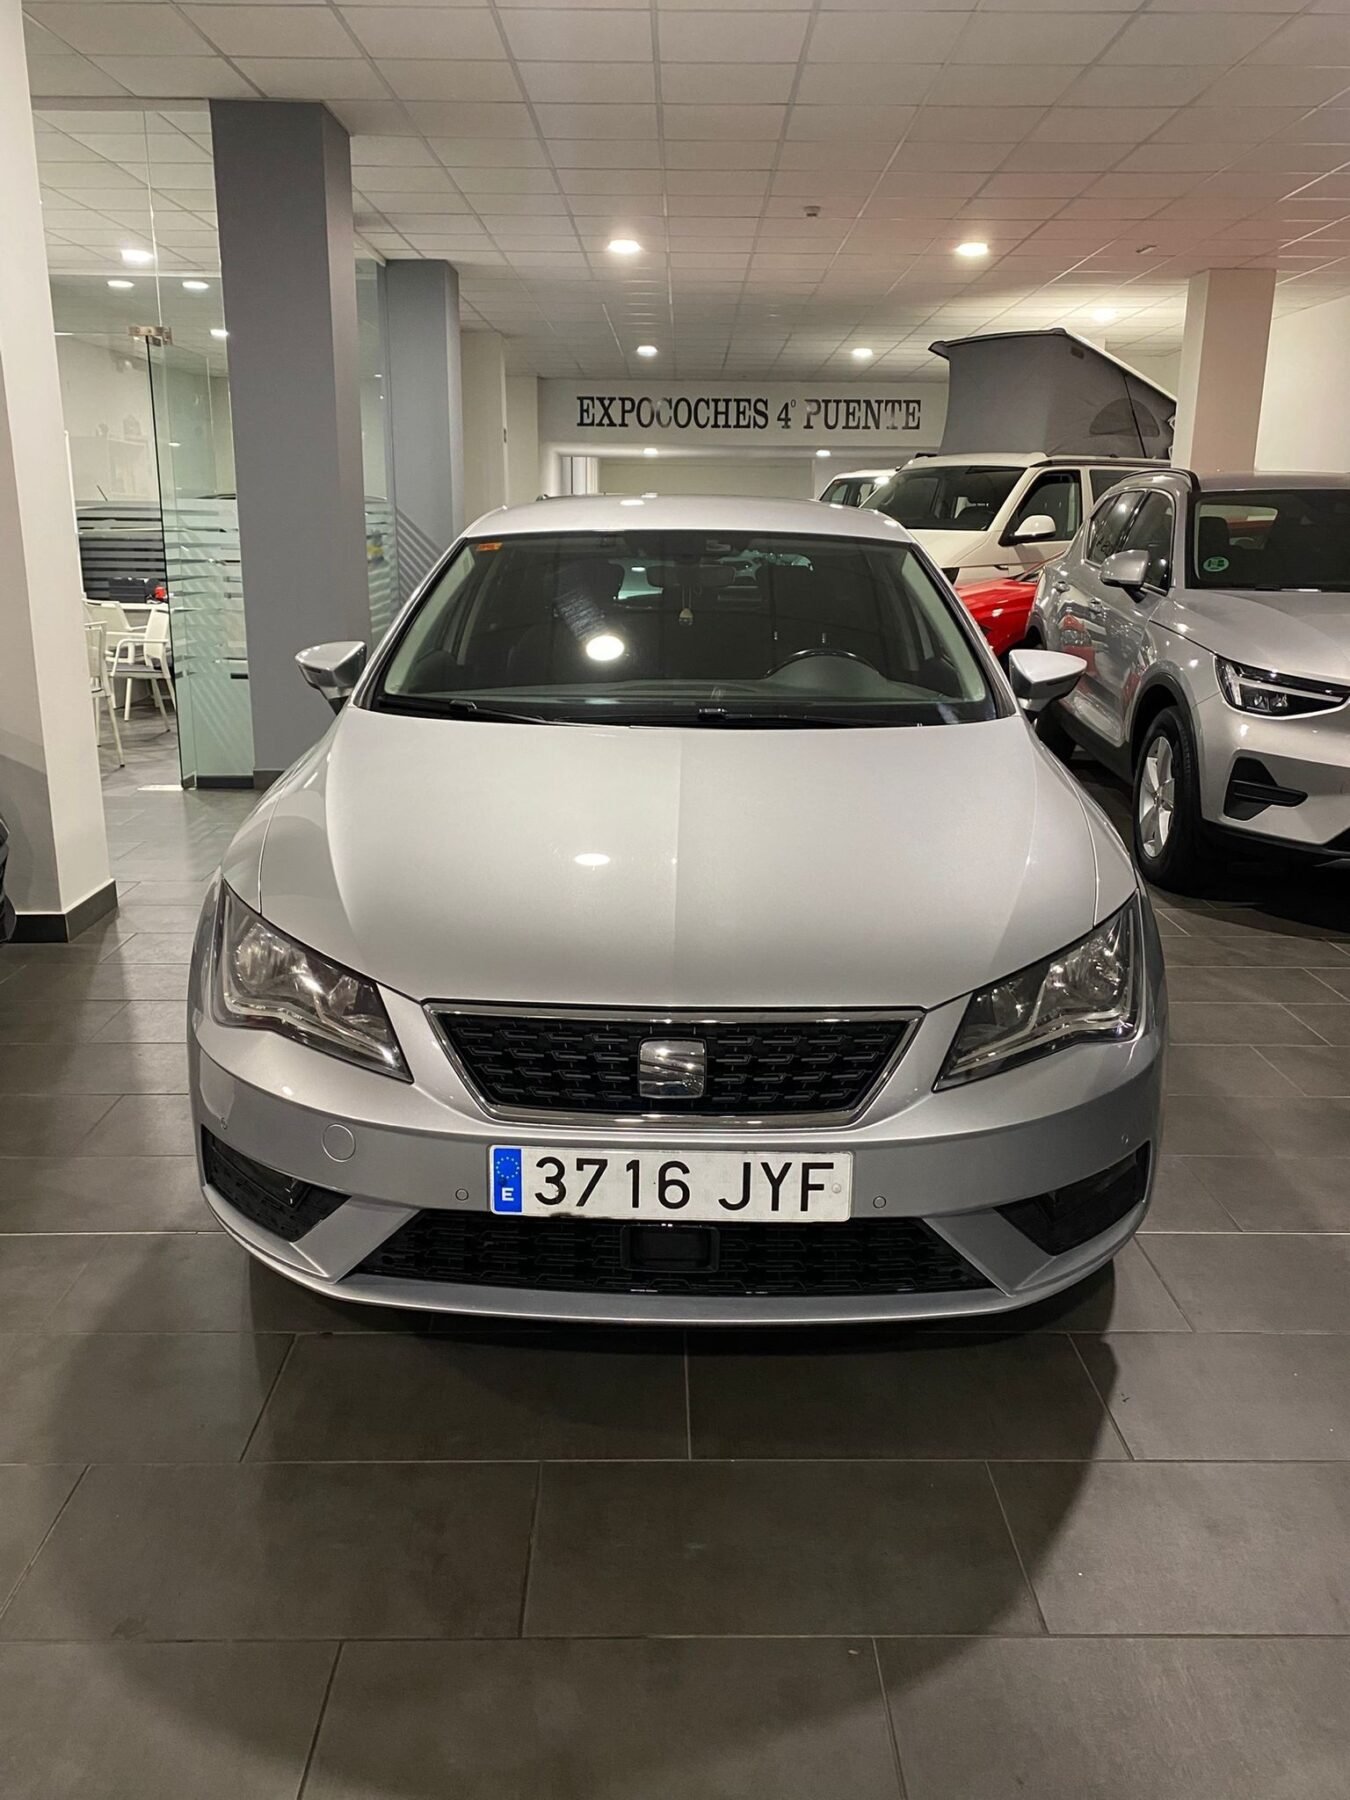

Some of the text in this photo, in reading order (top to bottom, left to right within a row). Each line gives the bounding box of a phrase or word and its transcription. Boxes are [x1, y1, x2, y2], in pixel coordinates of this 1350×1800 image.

[576, 396, 769, 430] EXPOCOCHES
[803, 399, 921, 431] PUENTE
[501, 1187, 514, 1202] E
[534, 1156, 835, 1212] 3716 JYF
